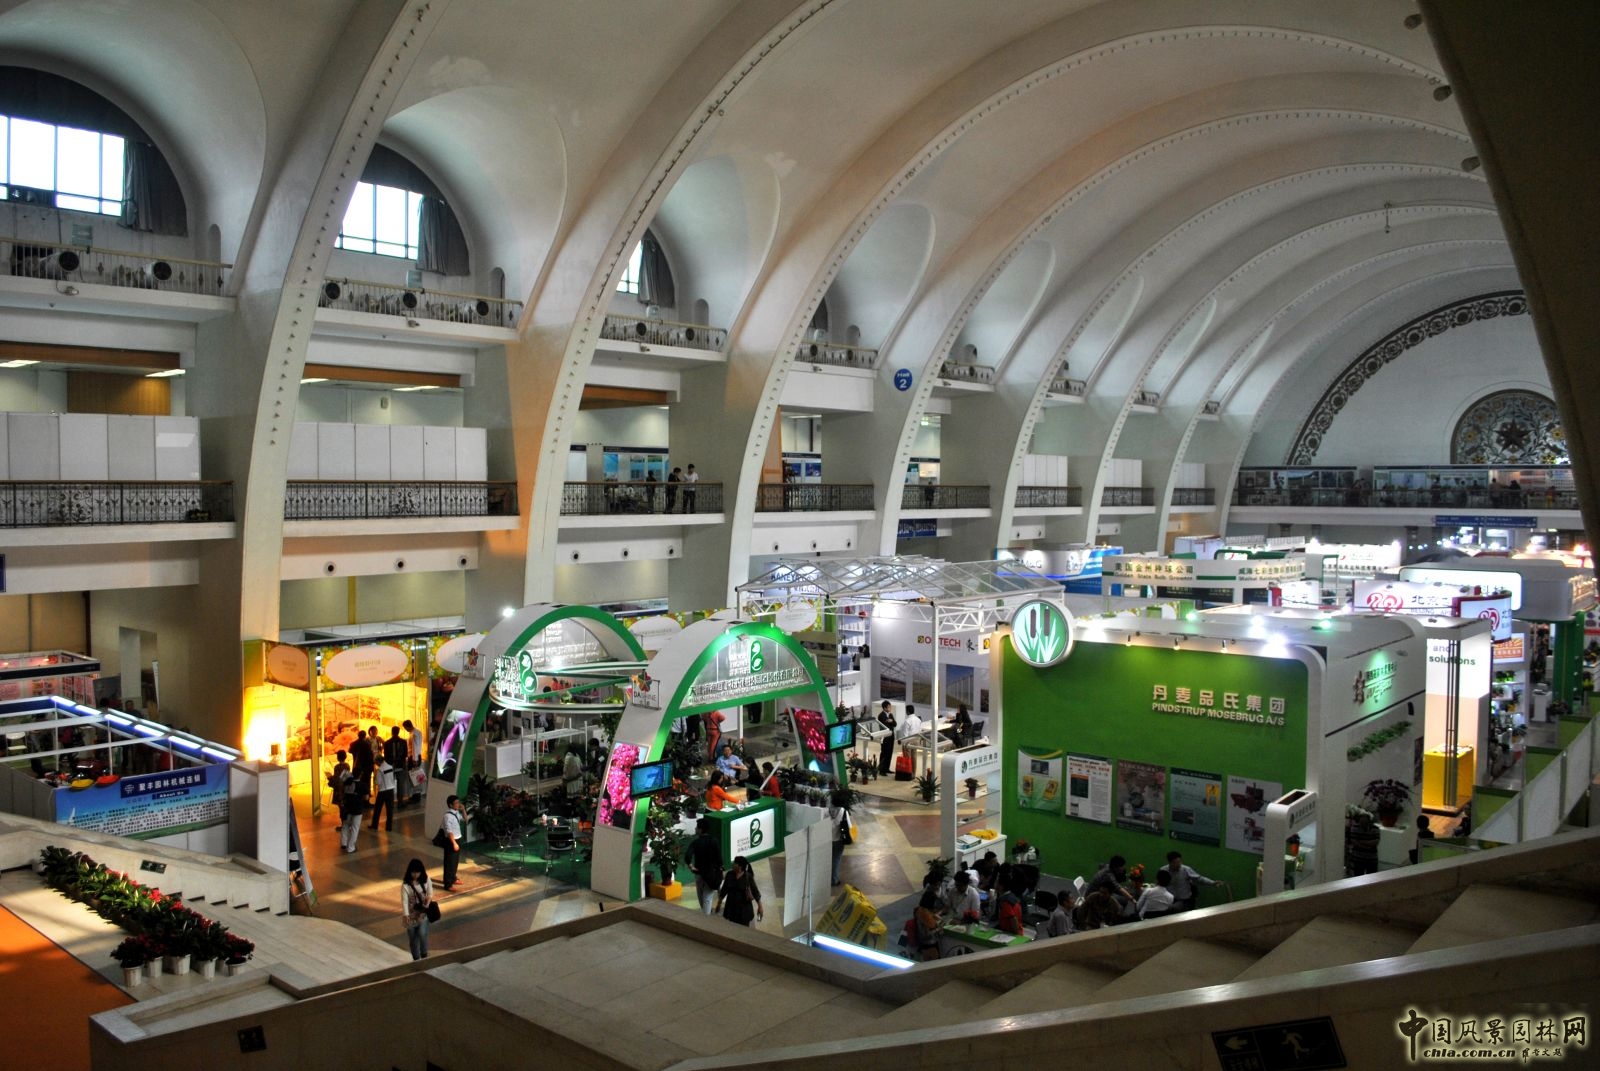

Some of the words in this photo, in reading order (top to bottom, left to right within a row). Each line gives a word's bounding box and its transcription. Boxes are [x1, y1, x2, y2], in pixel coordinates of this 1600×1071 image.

[900, 379, 908, 388] 2
[1153, 684, 1285, 714] 丹麦品氏集团
[1151, 702, 1206, 716] PINDSTRUP
[1207, 708, 1264, 723] MOSEBRUG
[1265, 715, 1285, 726] A/S
